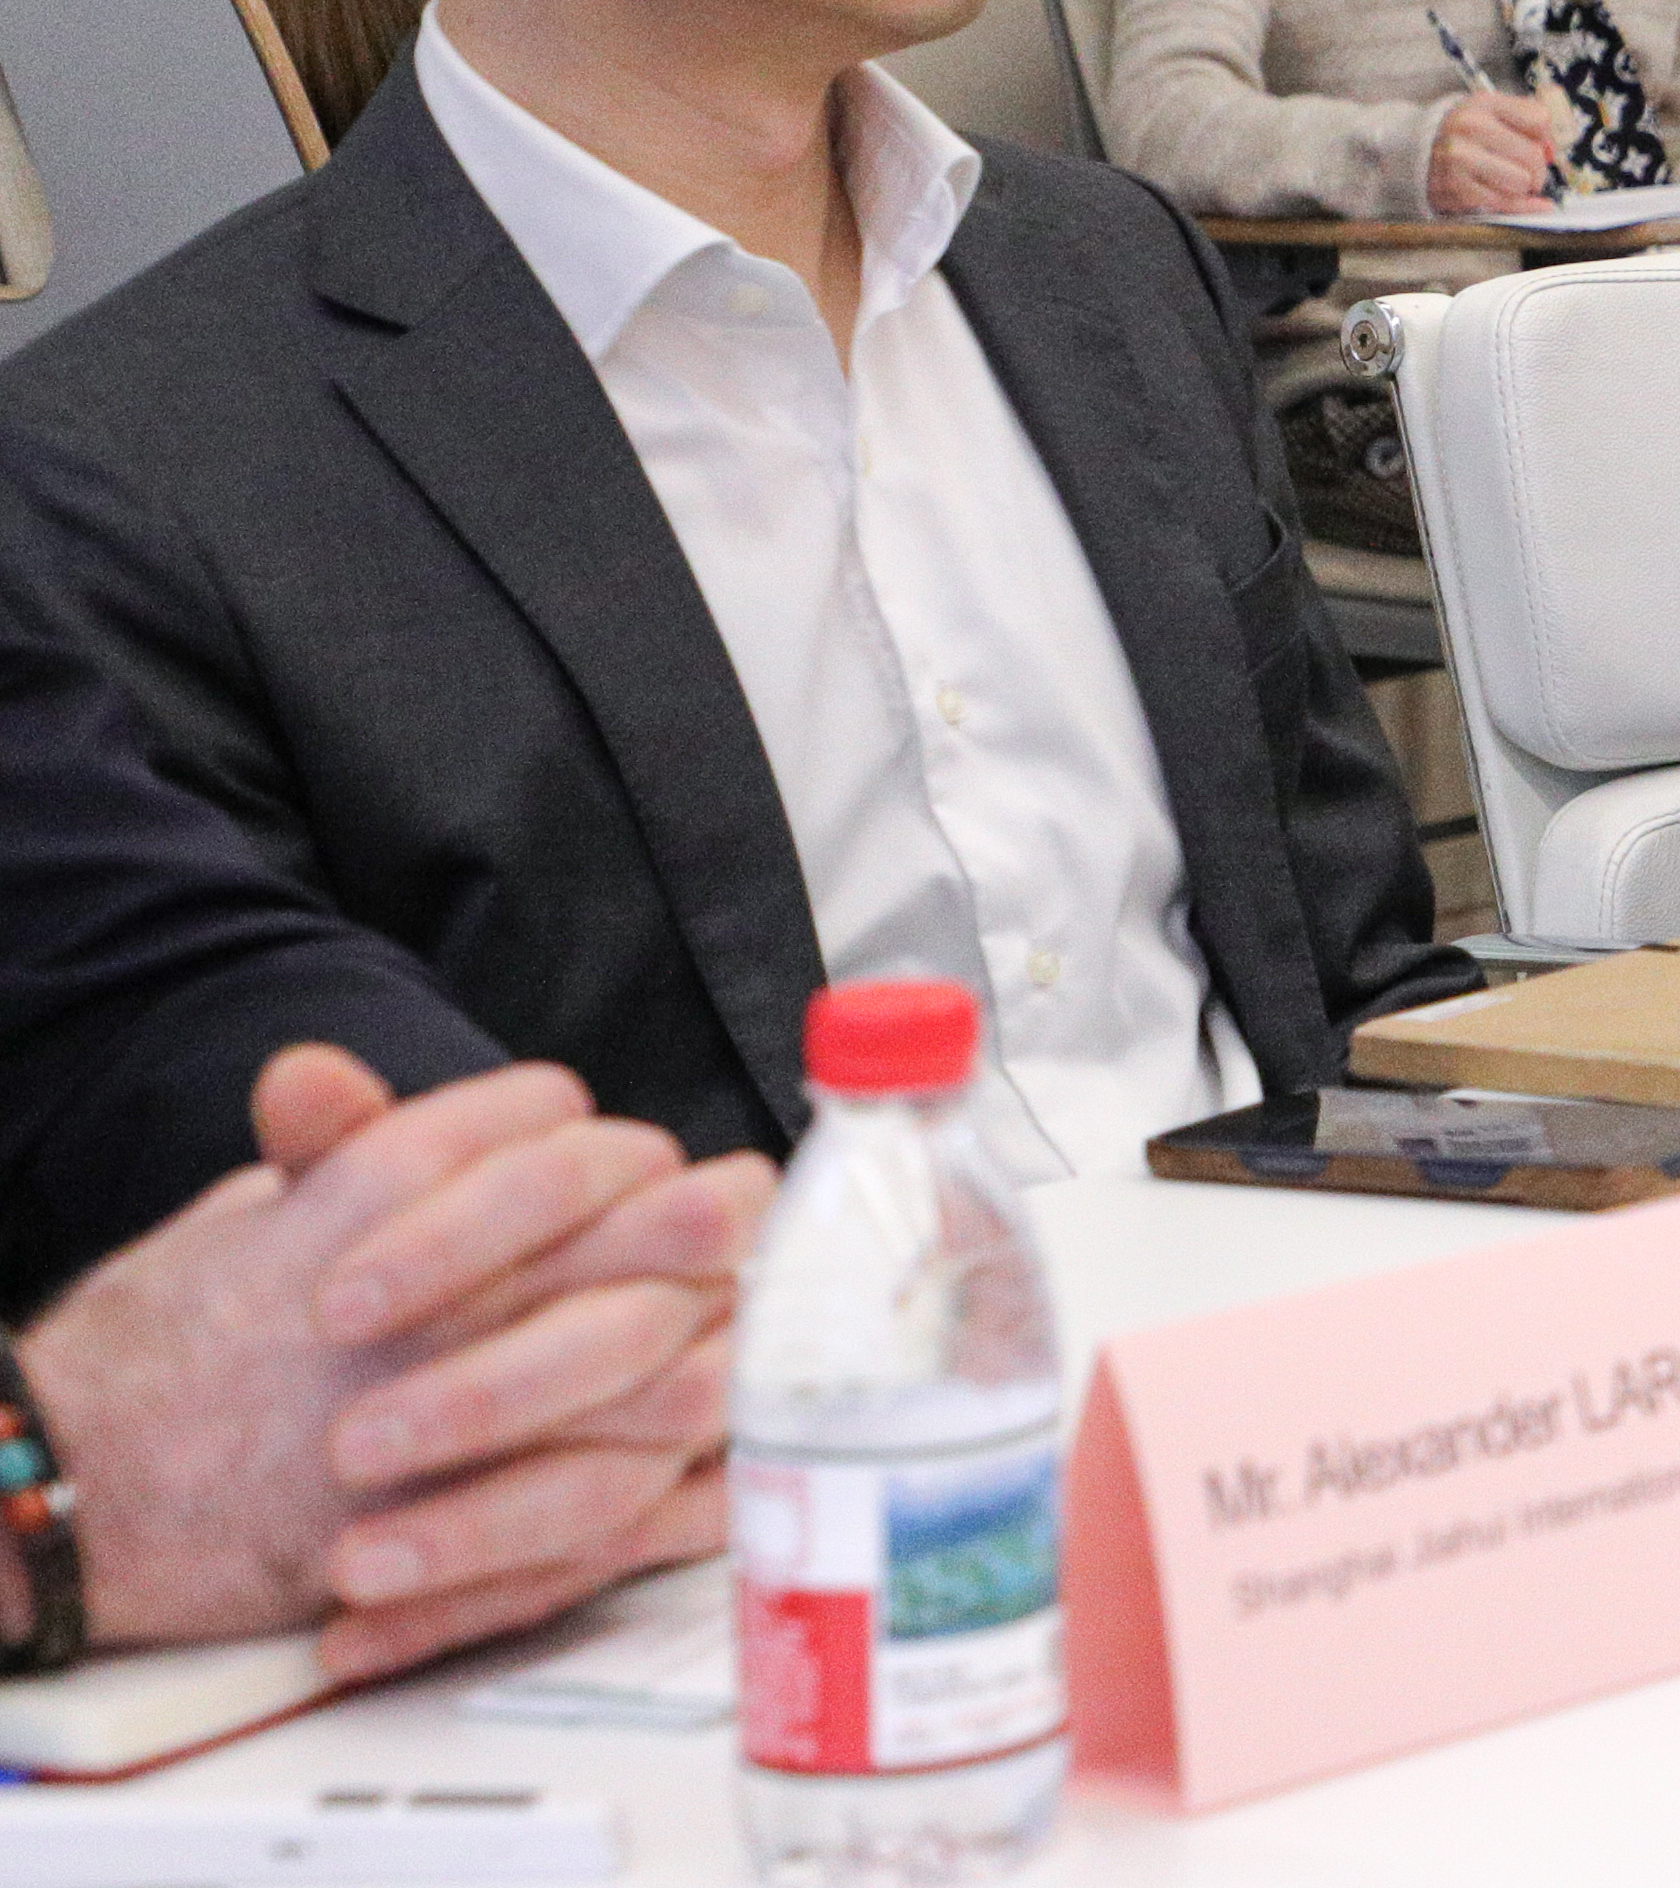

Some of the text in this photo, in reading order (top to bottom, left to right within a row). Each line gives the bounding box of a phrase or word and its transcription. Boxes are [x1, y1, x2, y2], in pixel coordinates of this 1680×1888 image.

[1203, 1457, 1298, 1534] Mr.
[1302, 1390, 1564, 1506] Alexander
[1229, 1543, 1400, 1622] Shanghai
